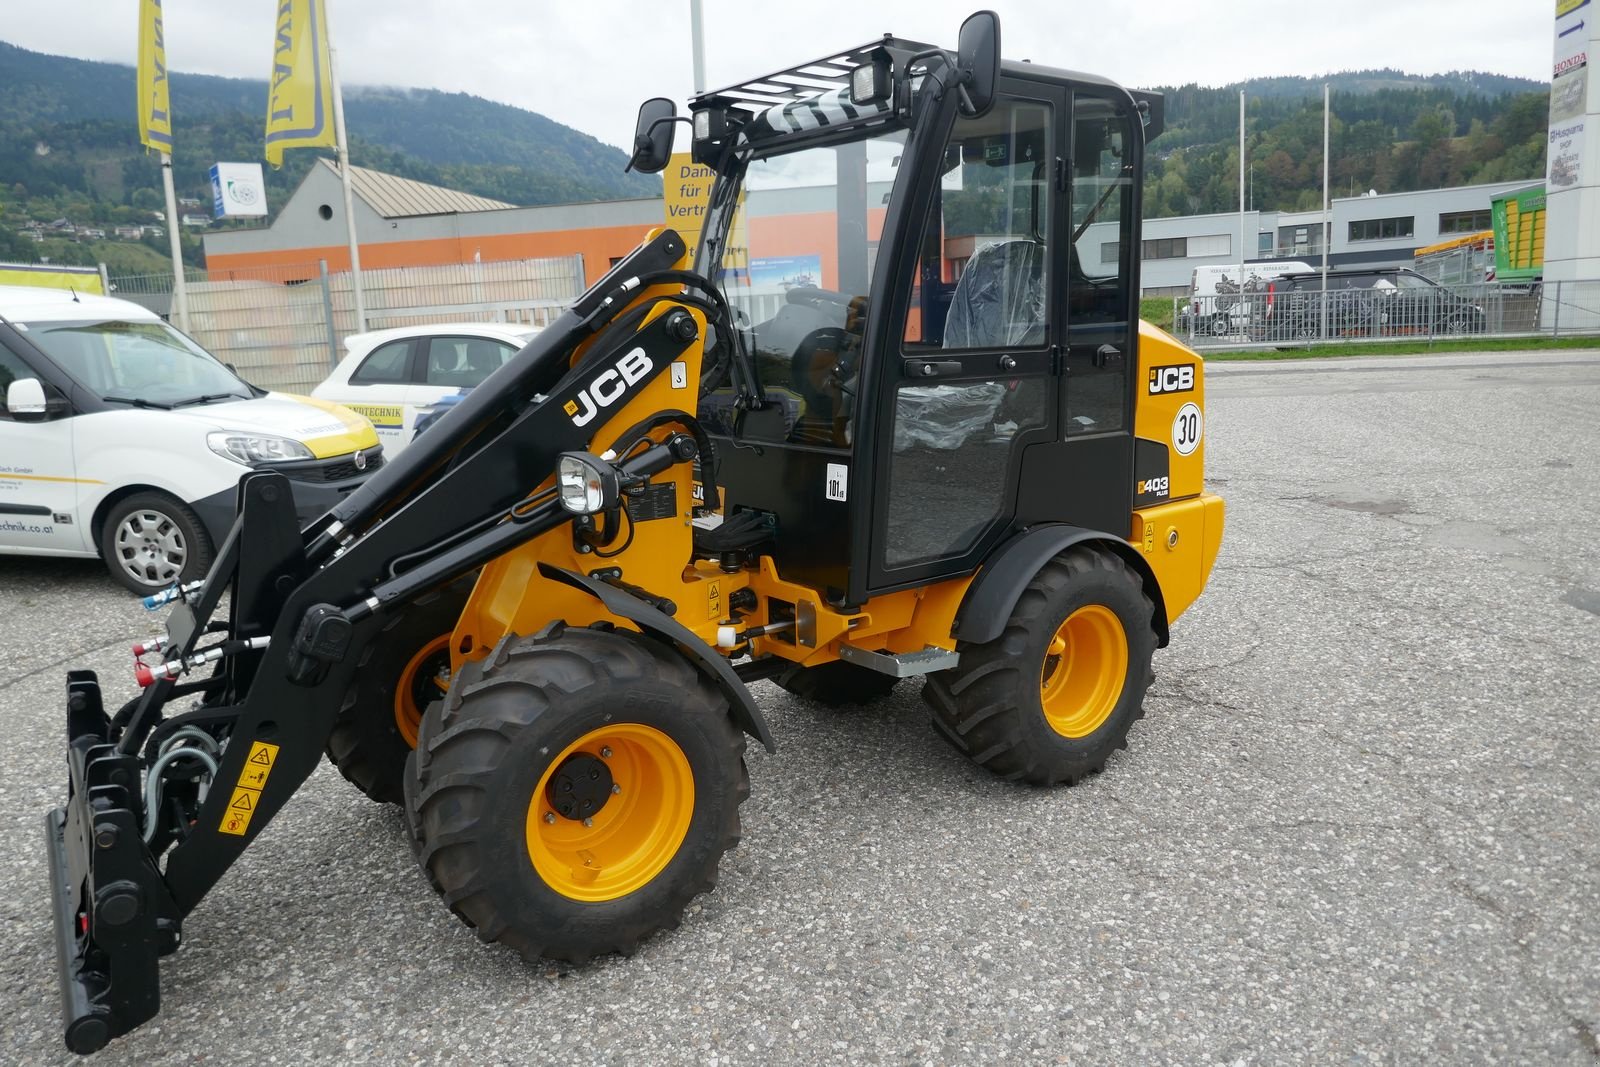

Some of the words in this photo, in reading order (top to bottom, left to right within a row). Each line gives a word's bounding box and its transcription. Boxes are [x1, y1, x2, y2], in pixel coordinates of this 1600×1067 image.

[1553, 52, 1587, 73] HONDA
[680, 183, 701, 197] für
[572, 347, 654, 427] JCB
[1150, 366, 1194, 393] JCB
[1178, 413, 1197, 445] 30
[829, 479, 840, 498] 101
[1144, 476, 1168, 492] 403
